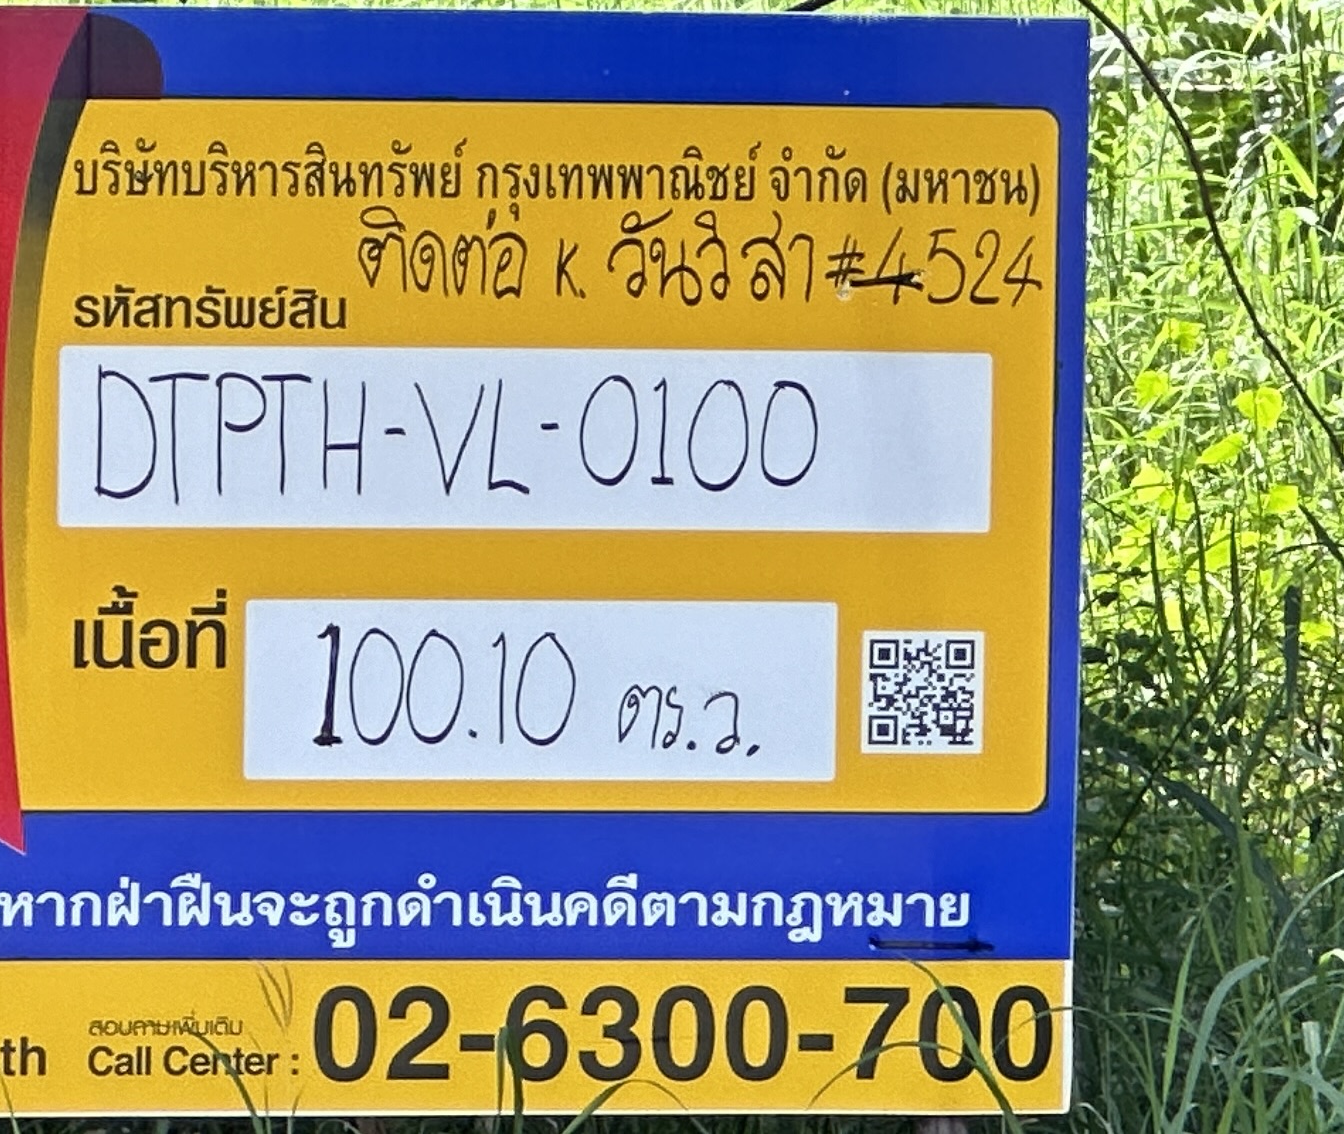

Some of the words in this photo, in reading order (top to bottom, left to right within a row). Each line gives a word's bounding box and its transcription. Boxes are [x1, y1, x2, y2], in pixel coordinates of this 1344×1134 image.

[74, 138, 468, 198] บริษัทบริหารสินทรัพย์
[476, 141, 761, 222] กรุงเทพพาณิชย์
[769, 145, 868, 203] จำกัด
[881, 162, 1041, 216] (มหาชน)
[358, 202, 526, 300] ติดต่อ
[74, 286, 347, 332] รหัสทรัพย์สิน
[94, 365, 819, 504] DTPTH-VL-0100
[72, 583, 227, 671] เนื้อที่
[313, 623, 576, 747] 100.10
[88, 1045, 152, 1076] Call
[163, 1046, 279, 1076] Center
[313, 984, 1054, 1082] 02-6300-700
